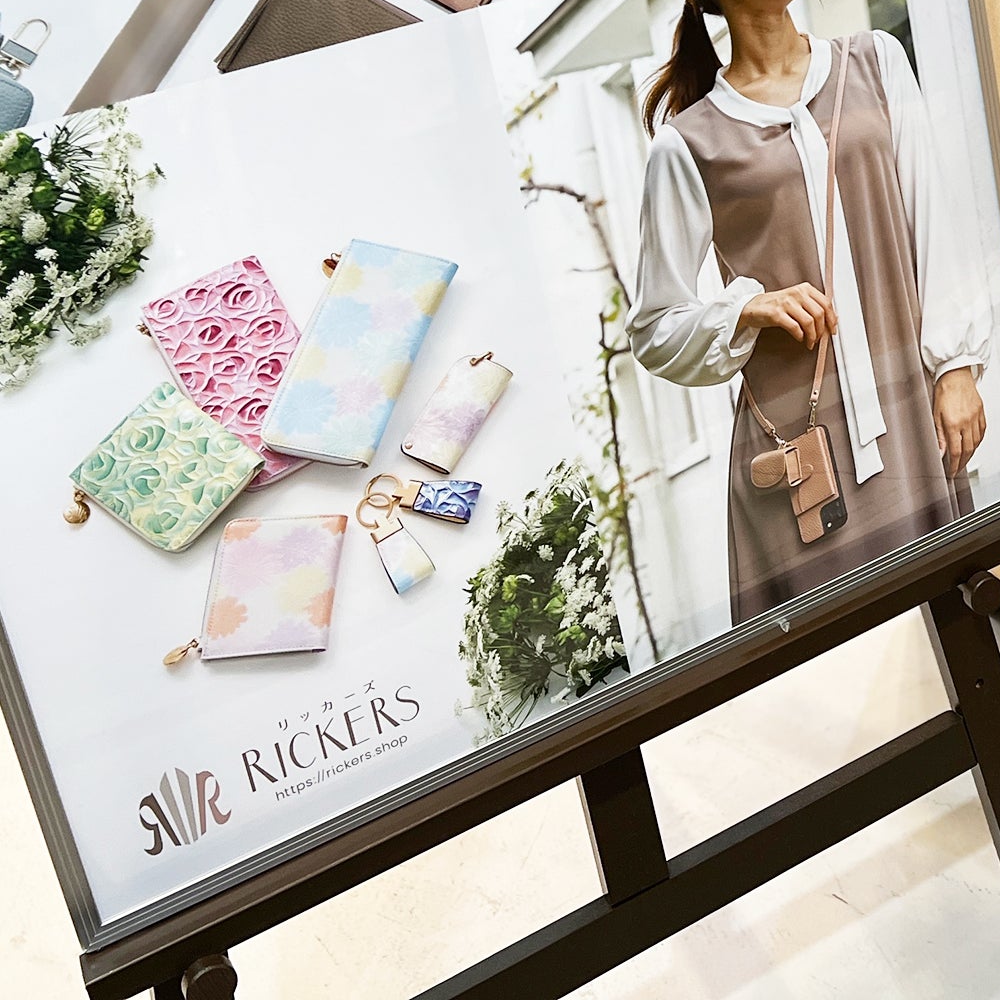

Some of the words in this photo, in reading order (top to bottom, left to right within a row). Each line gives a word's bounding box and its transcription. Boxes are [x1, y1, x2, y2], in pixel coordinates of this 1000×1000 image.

[241, 685, 420, 792] RICKERS
[278, 680, 375, 731] リッカーズ
[275, 733, 408, 801] https://rickers.shop
